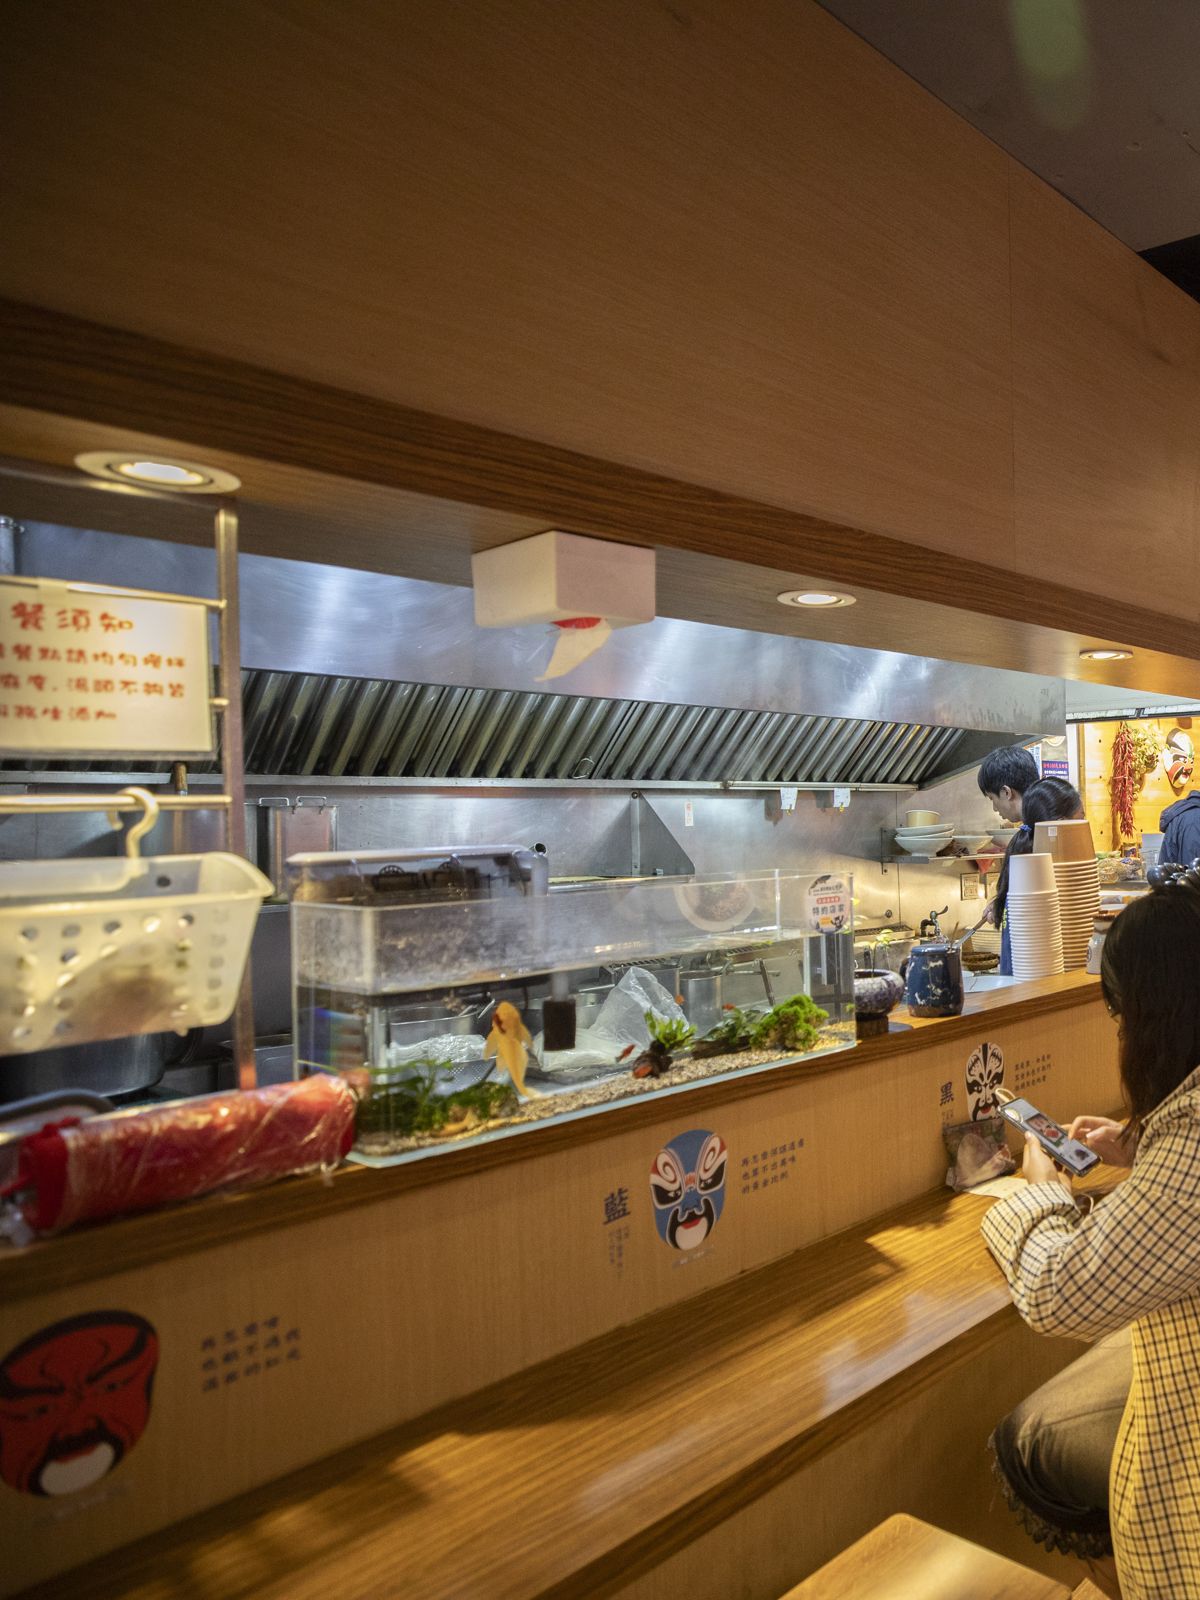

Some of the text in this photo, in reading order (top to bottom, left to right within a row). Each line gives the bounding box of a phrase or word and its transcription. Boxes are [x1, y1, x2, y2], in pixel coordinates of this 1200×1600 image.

[12, 602, 134, 632] 餐須知
[603, 1187, 631, 1225] 藍
